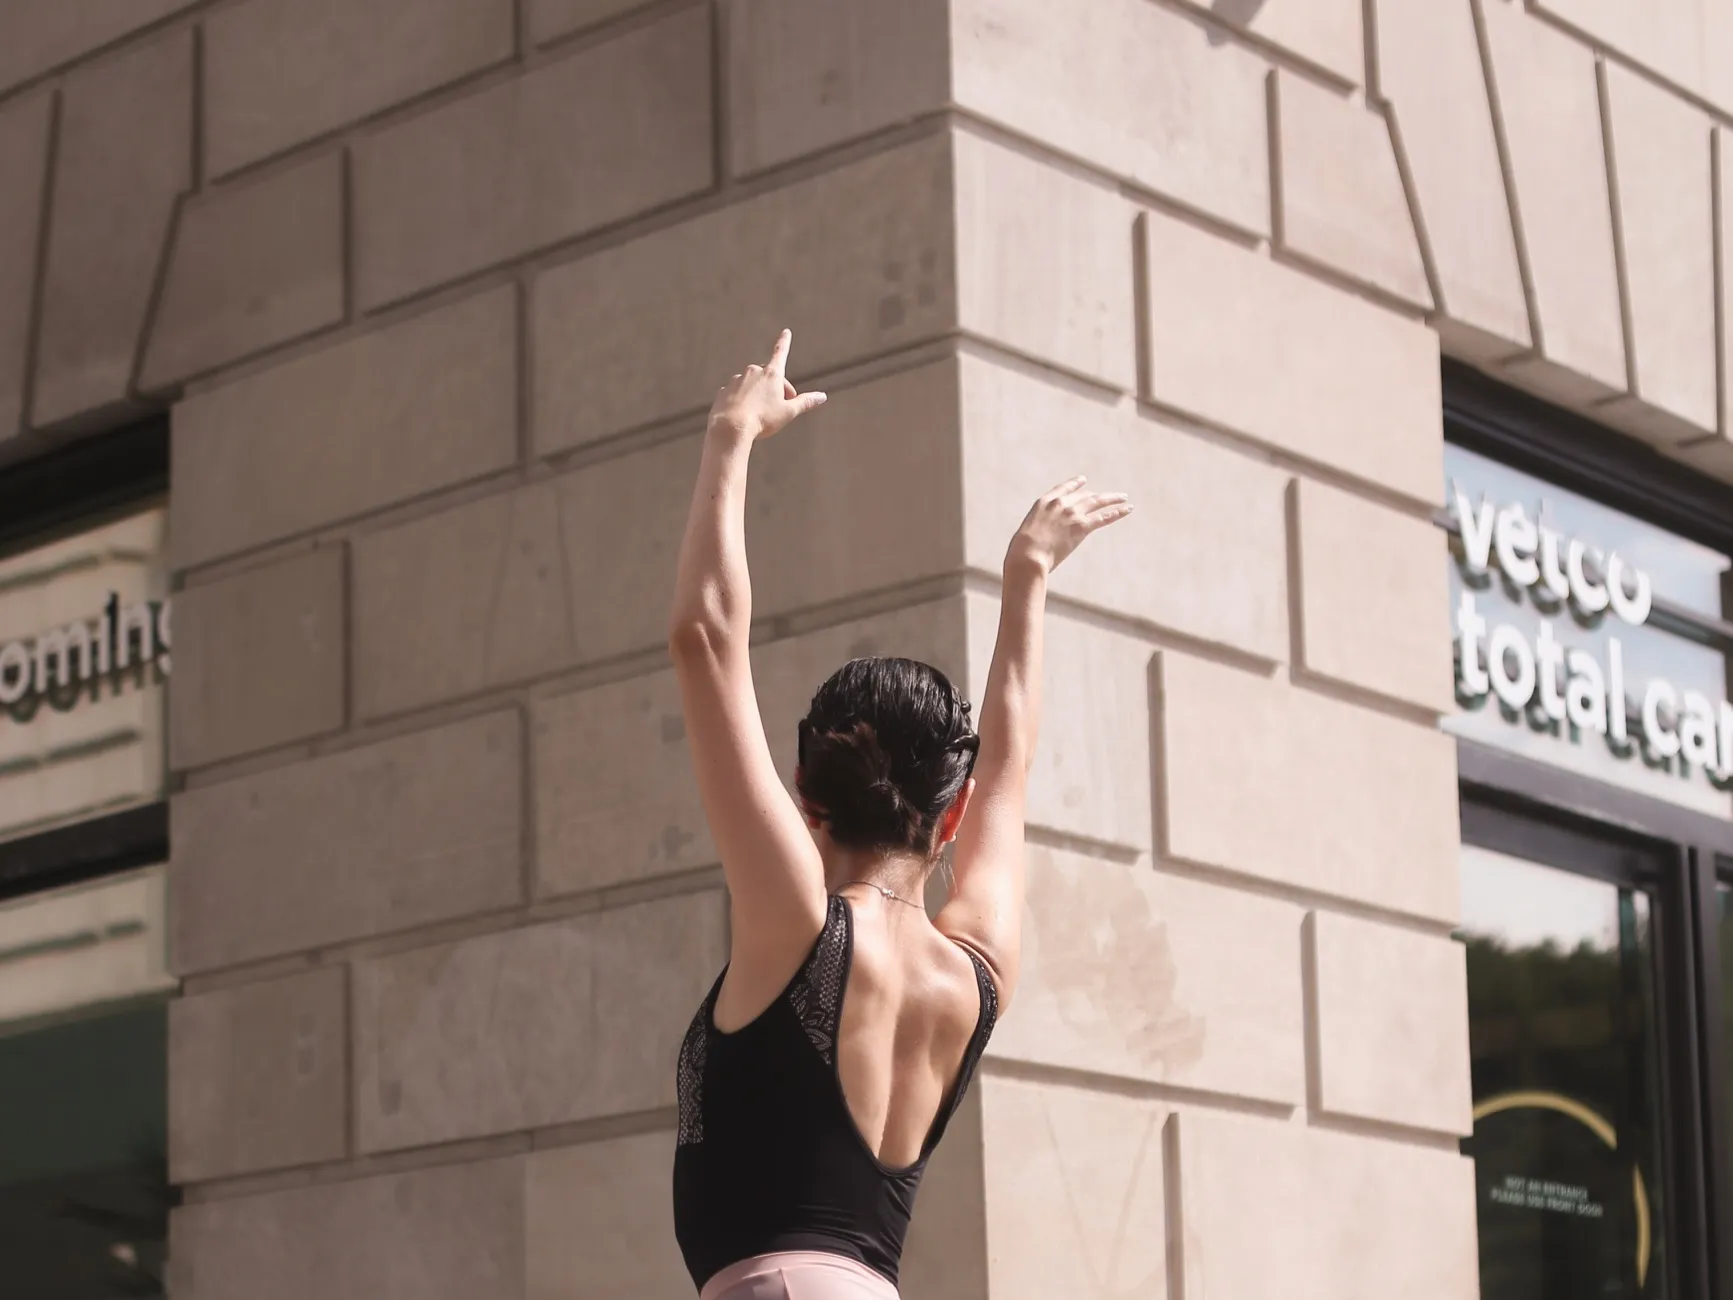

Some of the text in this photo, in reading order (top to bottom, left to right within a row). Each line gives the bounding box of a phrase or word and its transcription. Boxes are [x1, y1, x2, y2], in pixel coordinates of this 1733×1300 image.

[1452, 482, 1652, 625] vetco
[1457, 591, 1627, 742] total
[1490, 1187, 1525, 1205] PLEASE
[1547, 1197, 1576, 1213] FRONT
[1506, 1176, 1526, 1191] NOT
